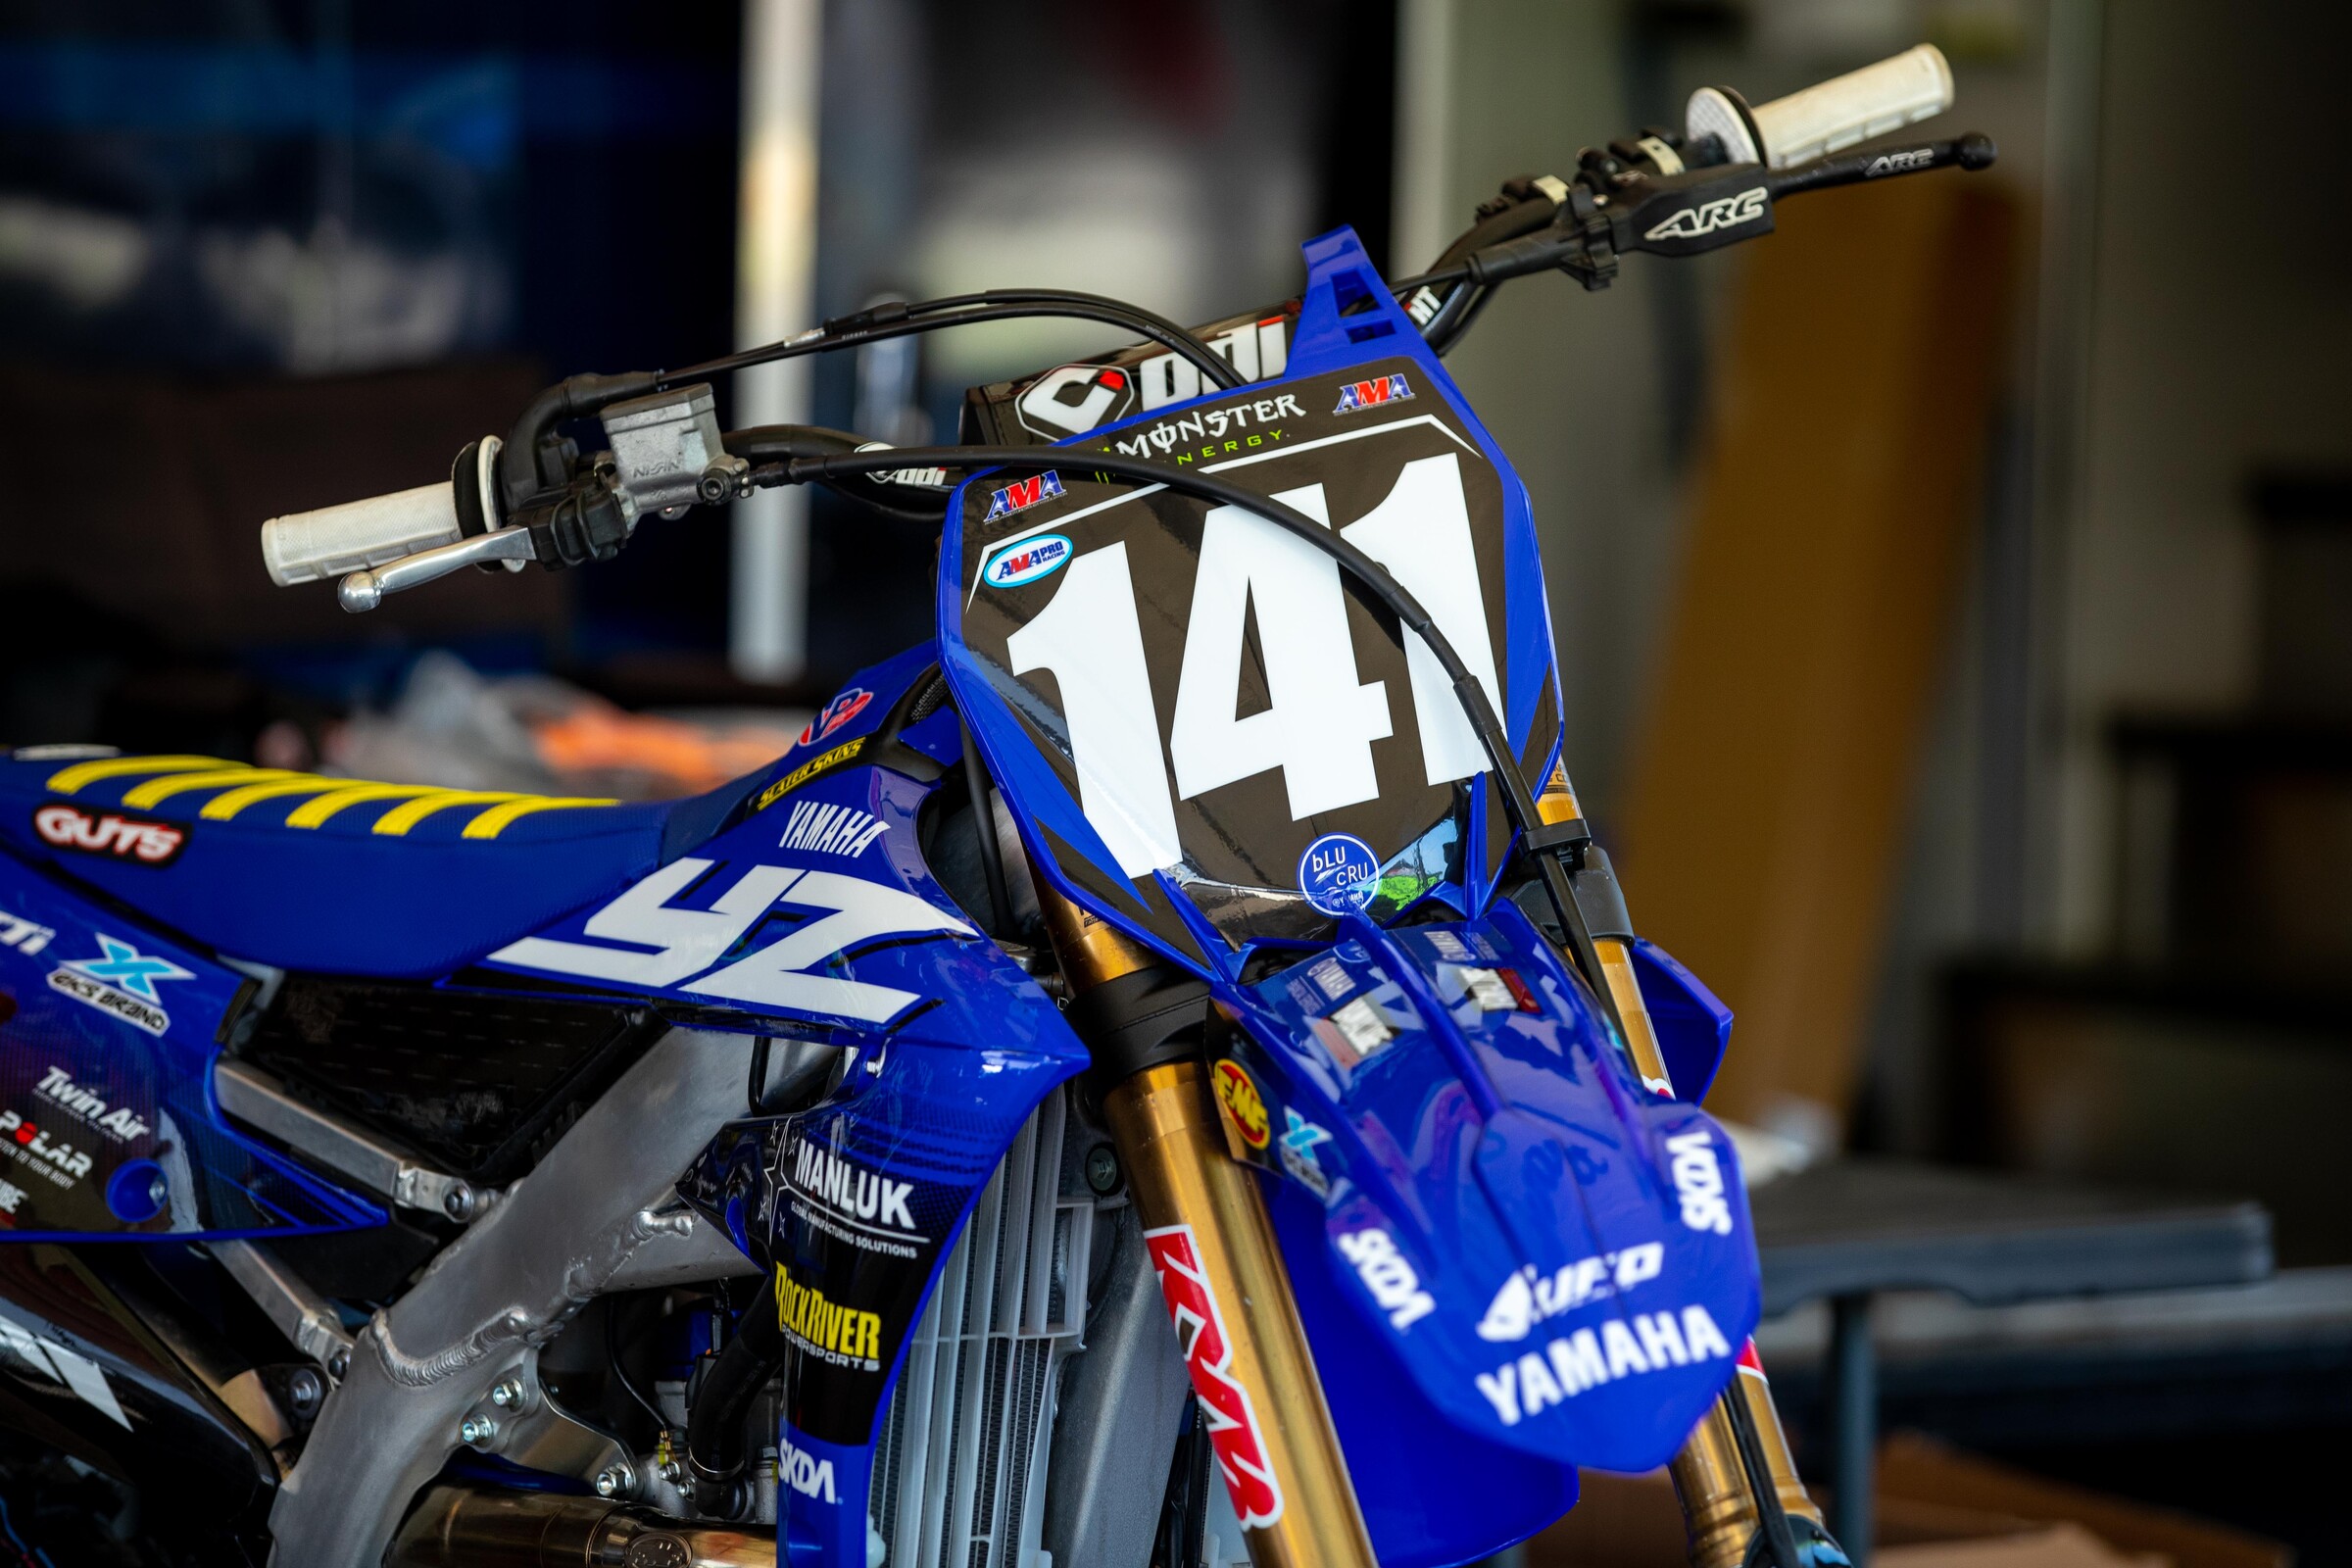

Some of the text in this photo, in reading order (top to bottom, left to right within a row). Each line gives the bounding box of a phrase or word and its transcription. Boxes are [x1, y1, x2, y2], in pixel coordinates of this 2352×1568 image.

[1865, 147, 1935, 177] ARC
[1643, 187, 1767, 240] ARC
[1332, 372, 1416, 415] AMA
[1115, 393, 1307, 460] MONSTER
[1166, 428, 1283, 466] NERGY
[983, 468, 1067, 523] AMA
[996, 540, 1064, 581] AMA PRO
[1042, 550, 1066, 564] RACING
[1005, 451, 1508, 880] 141
[35, 806, 183, 862] GUTS
[778, 800, 892, 858] YAMAHA
[487, 856, 984, 1025] YZ
[36, 1064, 108, 1120] Twin
[98, 1106, 151, 1142] Air
[0, 1108, 93, 1180] POLAR
[794, 1137, 917, 1230] MANLUK
[855, 1234, 918, 1260] SOLUTIONS
[780, 1322, 881, 1373] POWERSPORTS
[1474, 1303, 1733, 1427] YAMAHA
